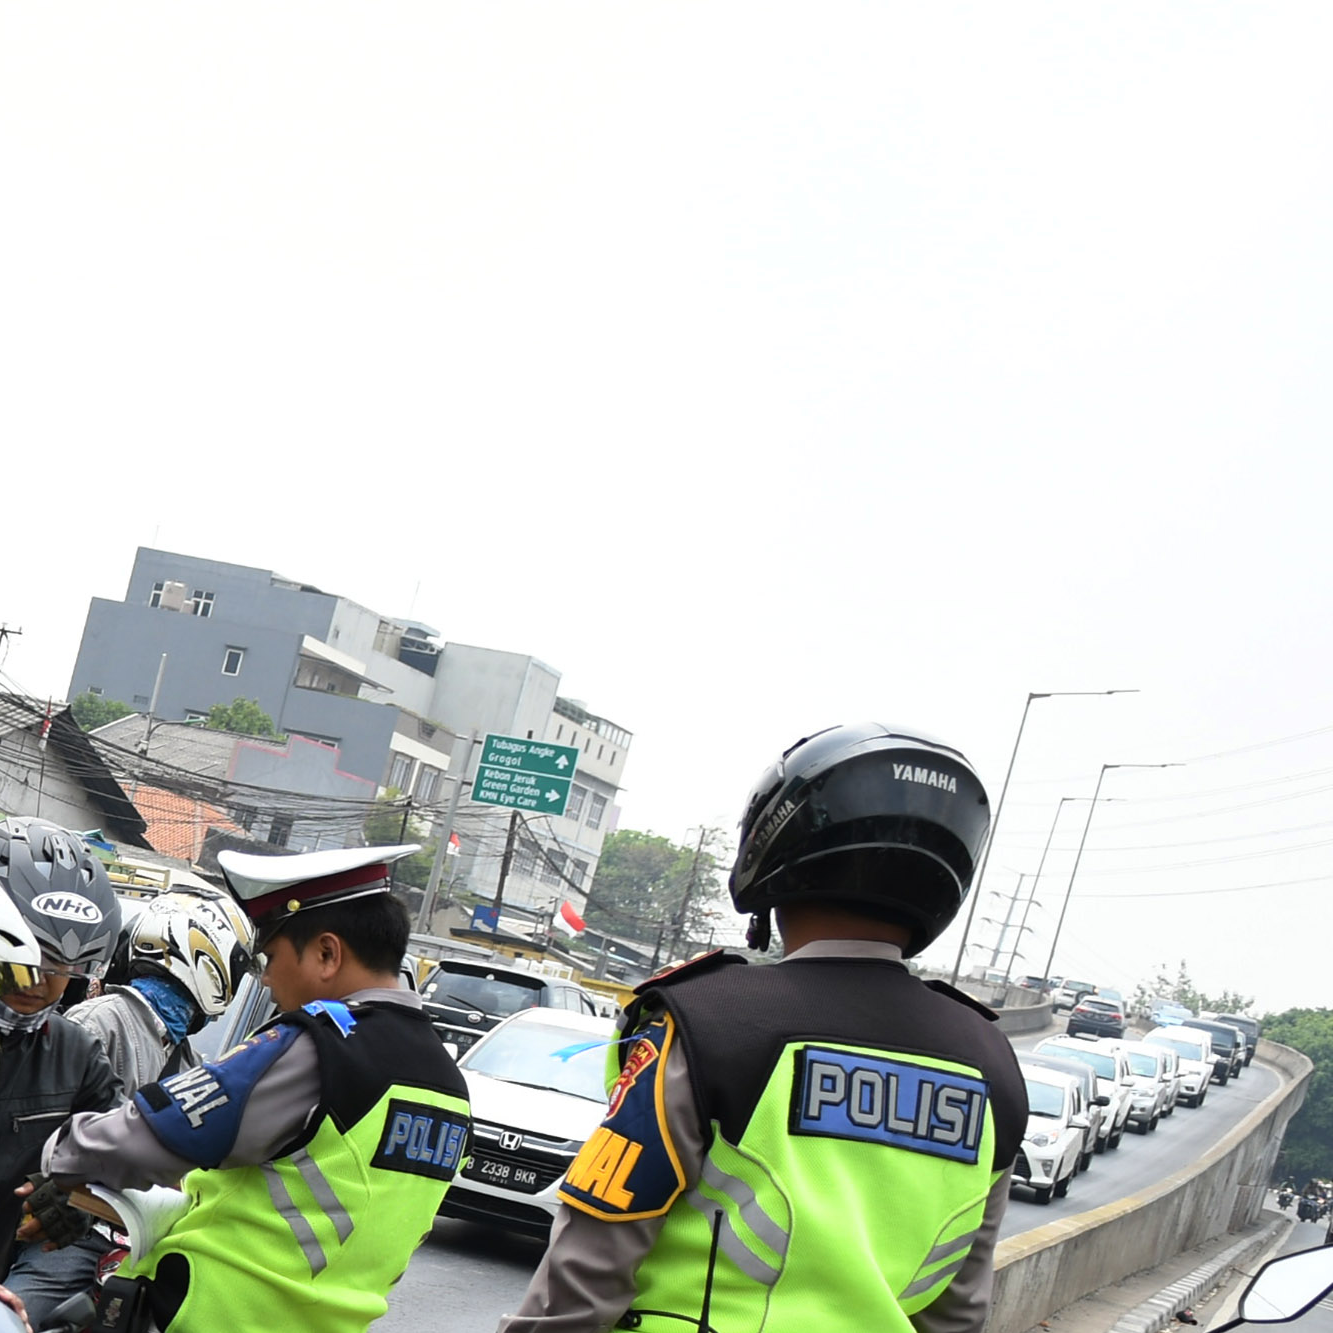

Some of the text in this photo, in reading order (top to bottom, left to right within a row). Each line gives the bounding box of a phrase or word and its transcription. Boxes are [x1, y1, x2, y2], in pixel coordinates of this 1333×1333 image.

[492, 738, 556, 758] Tubagus Angke
[488, 752, 522, 766] Grogol
[483, 768, 537, 786] Kebon Jeruk
[892, 762, 958, 794] YAMAHA
[478, 789, 537, 807] KMN Eye Care
[481, 779, 541, 797] Green Garden
[754, 799, 796, 849] YAMAHA
[804, 1059, 983, 1149] POLISI
[466, 1157, 537, 1185] B 2338 BKR
